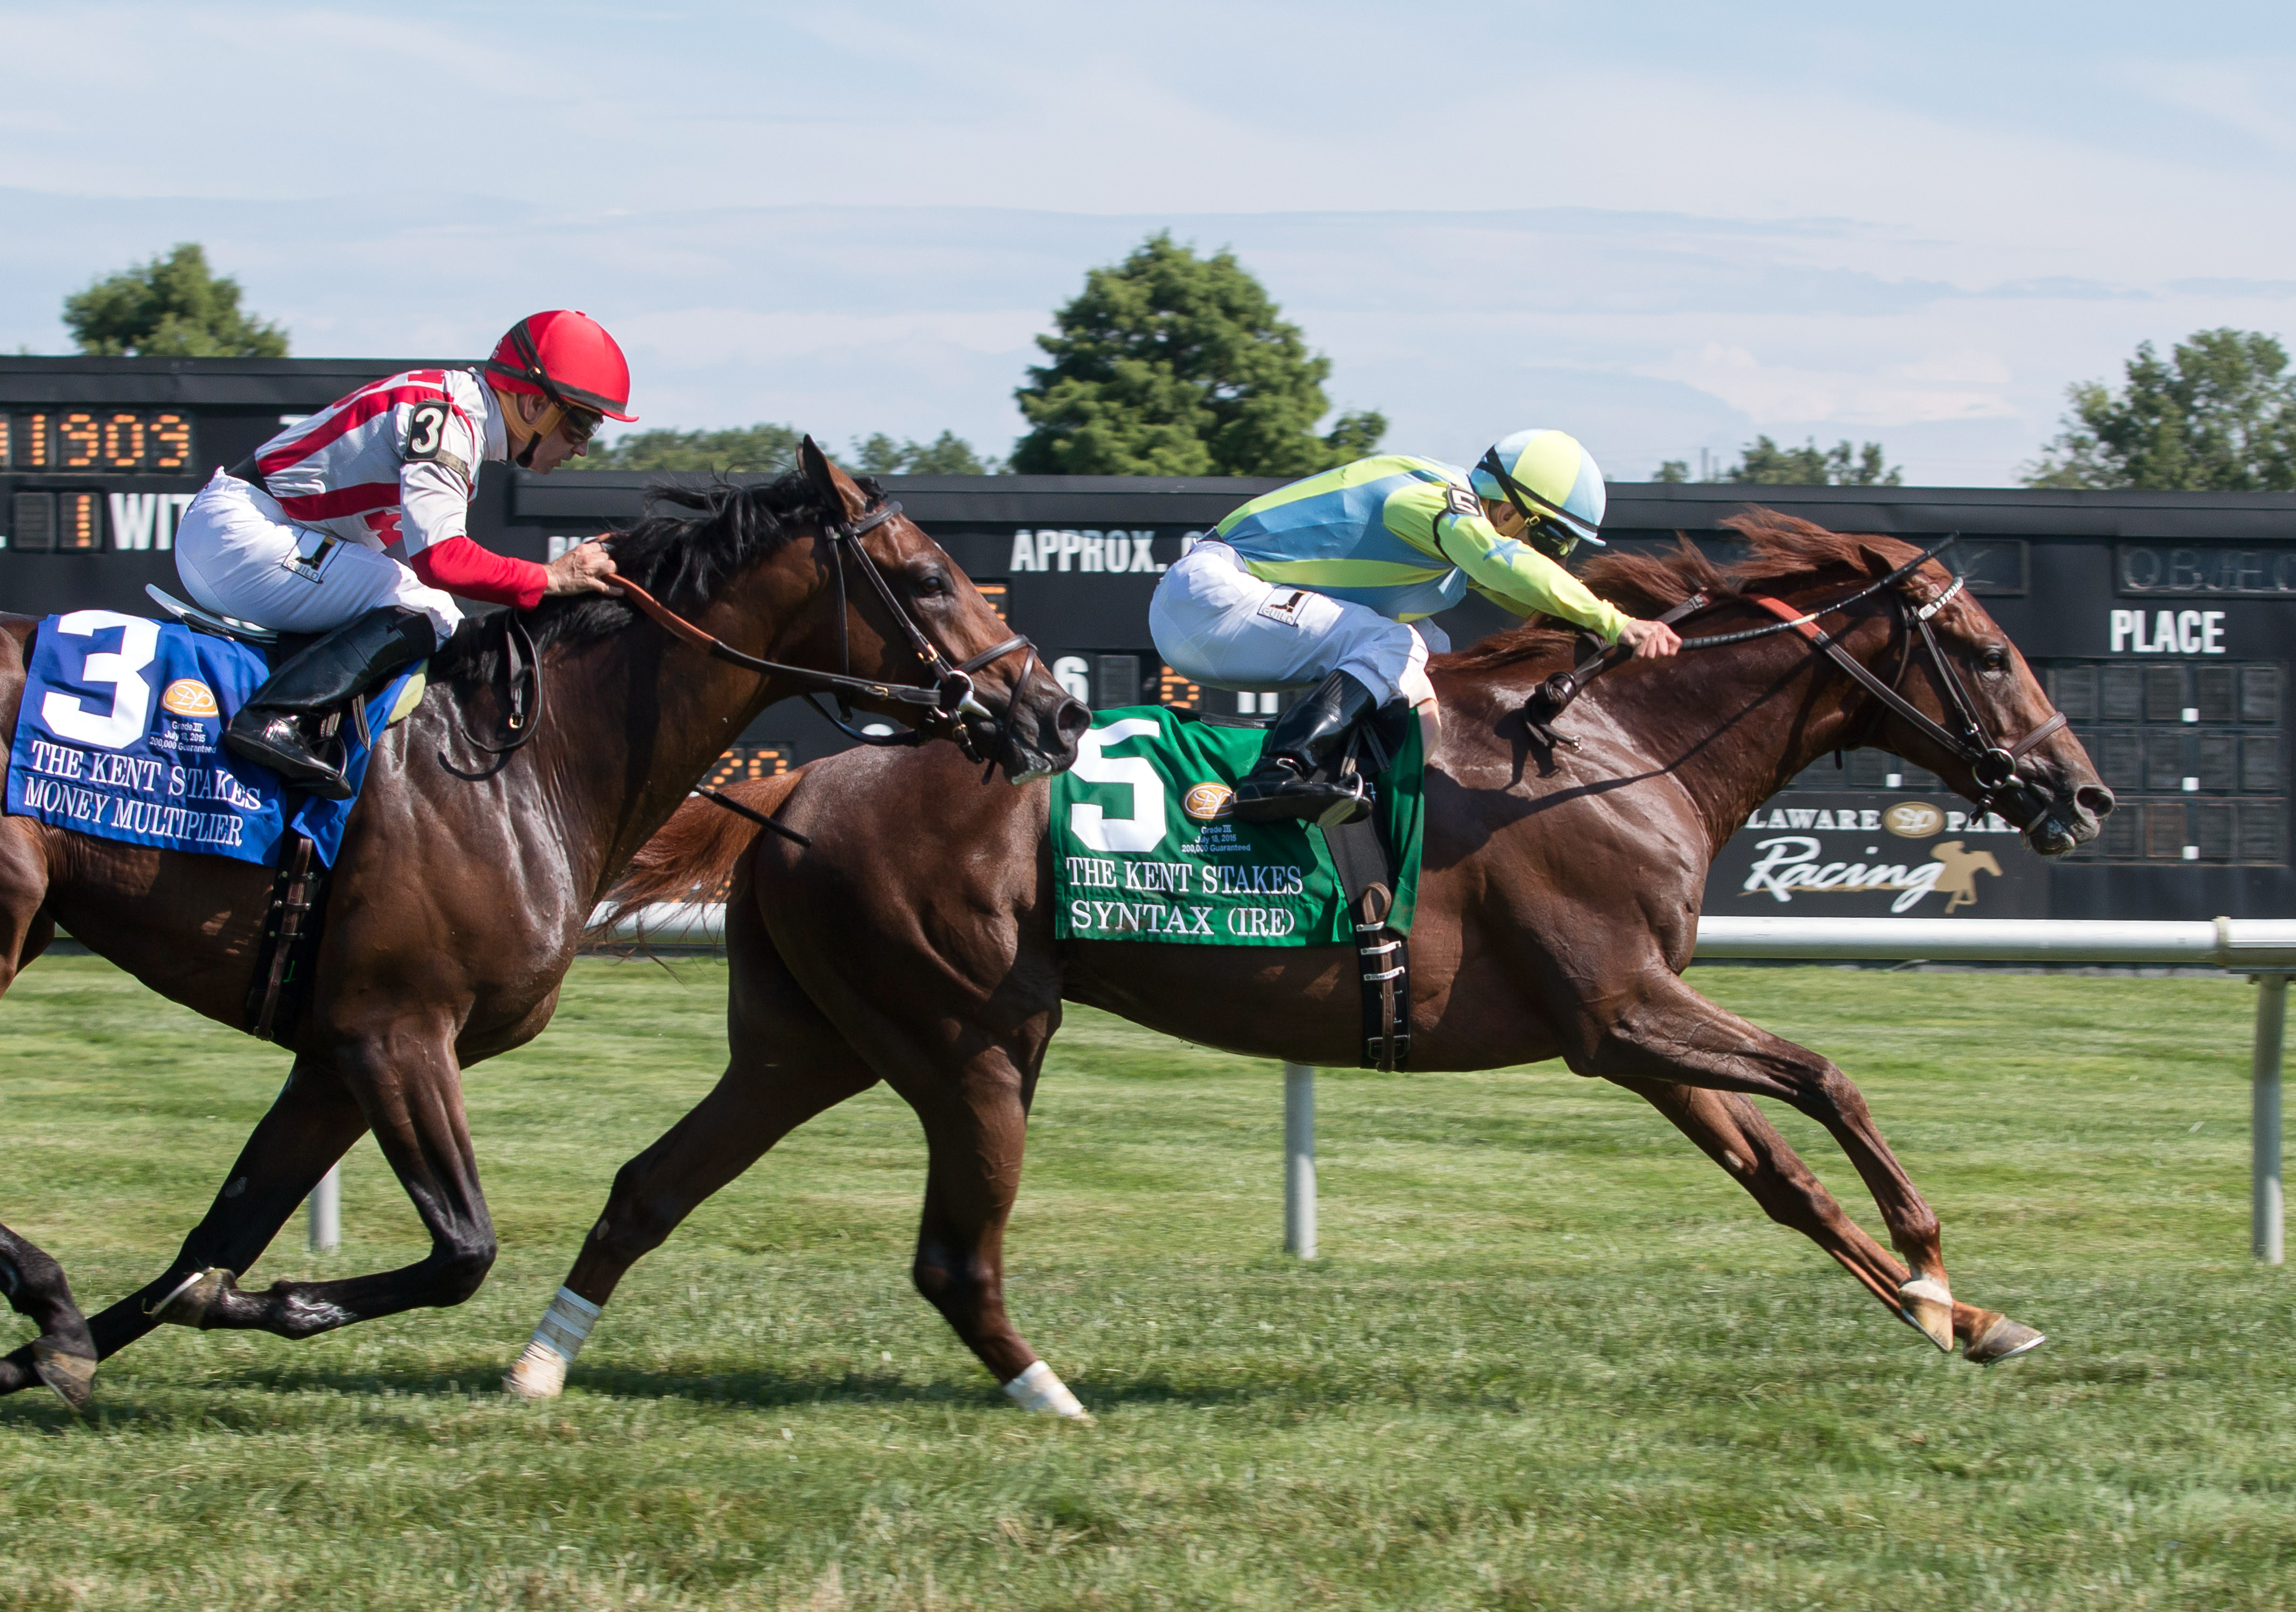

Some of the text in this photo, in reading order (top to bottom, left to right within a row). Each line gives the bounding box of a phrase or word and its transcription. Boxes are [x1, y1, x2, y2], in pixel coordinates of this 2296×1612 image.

[412, 407, 443, 454] 3
[1010, 529, 1168, 572] APPROX.
[286, 560, 319, 579] GUILD
[1262, 607, 1293, 623] GUILD
[2110, 610, 2226, 653] PLACE
[41, 610, 160, 749] 3
[150, 737, 177, 750] 200,000
[165, 730, 179, 741] July
[190, 733, 206, 743] 2015
[172, 721, 193, 731] Grade
[32, 740, 261, 810] THE KENT STAKES
[1071, 718, 1167, 852] 5
[24, 776, 243, 846] MONEY MULTIPLIER
[1201, 824, 1232, 834] Grade III
[1181, 843, 1251, 854] 200,000 Guaranteed
[1195, 834, 1237, 844] July 18, 2015
[1066, 857, 1303, 895] THE KENT STAKES
[1743, 836, 1947, 914] Racing
[1071, 900, 1295, 937] SYNTAX (IRE)
